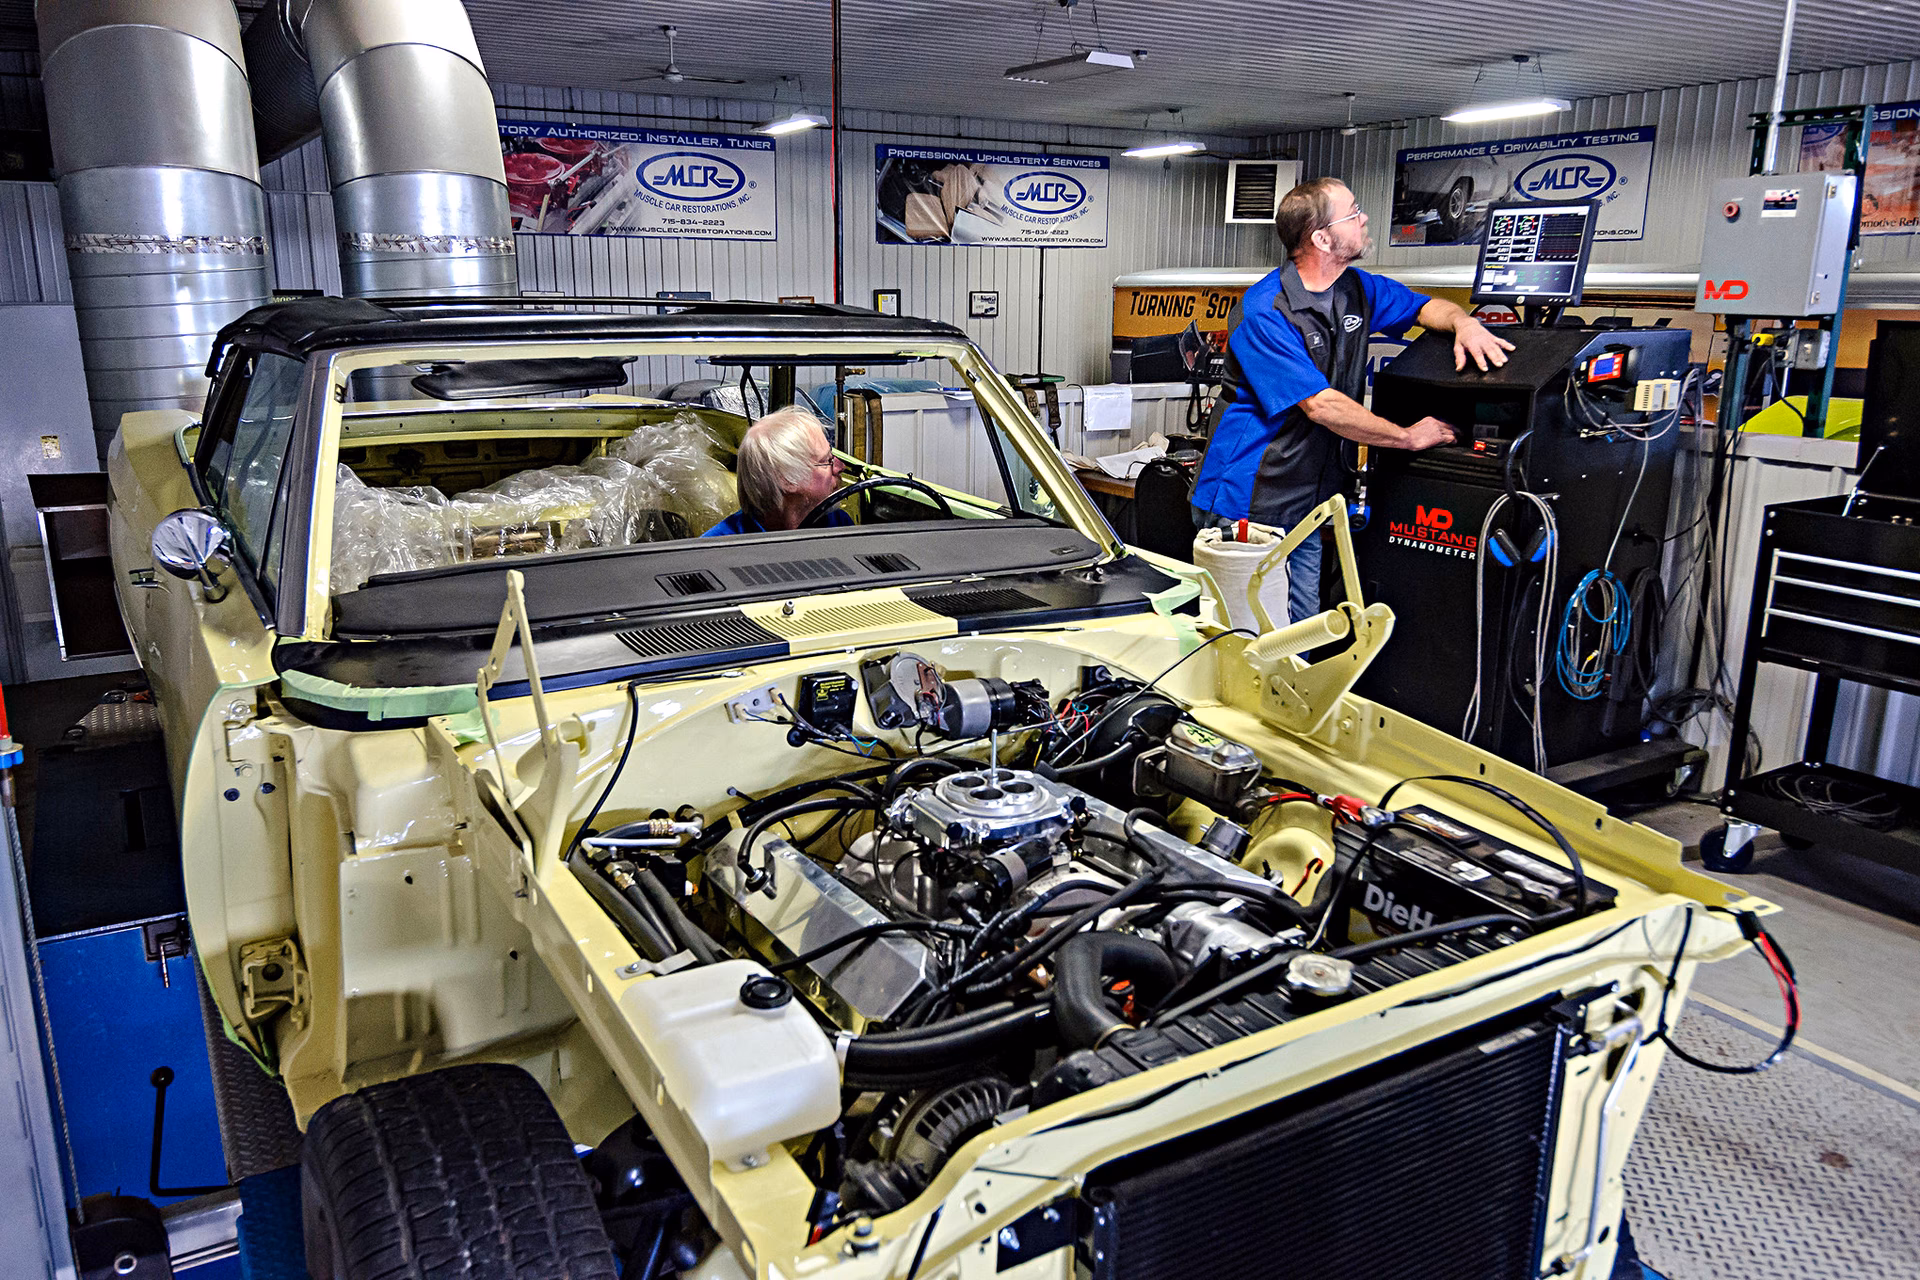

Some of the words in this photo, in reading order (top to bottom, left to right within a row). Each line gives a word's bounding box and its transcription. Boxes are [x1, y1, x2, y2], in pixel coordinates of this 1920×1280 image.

[546, 127, 643, 142] AUTHORIZED:
[646, 133, 723, 148] INSTALLER,
[727, 138, 772, 150] TUNER
[1406, 147, 1485, 162] PERFORMANCE
[1489, 145, 1500, 155] &
[1503, 138, 1579, 153] DRIVABILITY
[1583, 132, 1640, 146] TESTING
[888, 148, 973, 162] PROFESSIONAL
[976, 153, 1049, 166] UPHOLSTERY
[1052, 157, 1101, 168] SERVICES
[653, 164, 736, 189] MCR
[1527, 165, 1606, 192] MCR
[633, 188, 664, 209] MUSCLE
[664, 202, 681, 213] CAR
[1015, 183, 1079, 202] MCR
[661, 217, 726, 228] 715-834-2223
[1000, 204, 1023, 221] MUSCLE
[1024, 214, 1037, 224] CAR
[610, 225, 773, 237] WWW.MUSCLECARRESTORATIONS.COM
[1704, 280, 1750, 300] MD
[1129, 291, 1197, 318] TURNING
[1416, 504, 1454, 530] MD
[1389, 521, 1478, 548] MUSTANG
[1388, 535, 1477, 560] DYNAMOMETER
[1362, 881, 1441, 933] DieH
